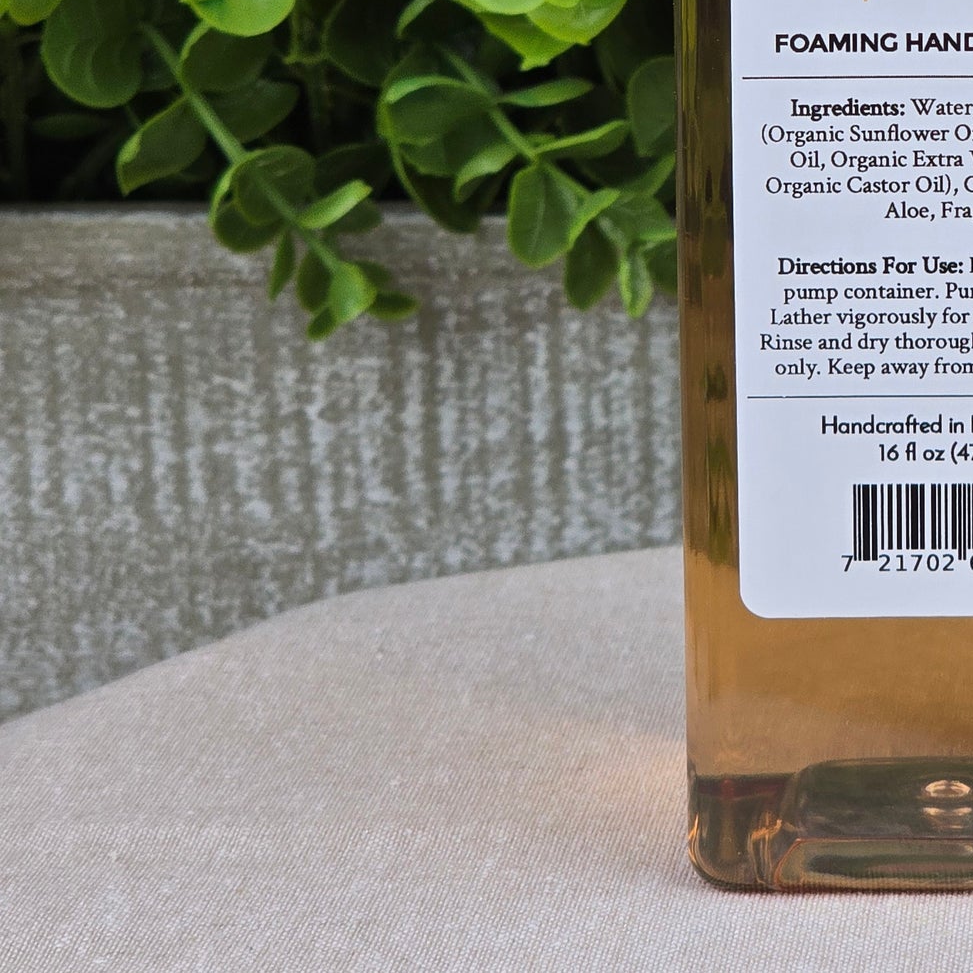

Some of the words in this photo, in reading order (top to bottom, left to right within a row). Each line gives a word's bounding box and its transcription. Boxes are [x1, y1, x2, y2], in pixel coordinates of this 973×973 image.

[775, 32, 899, 54] FOAMING
[790, 97, 906, 121] Ingredients:
[761, 123, 845, 146] (Organic
[849, 123, 950, 142] Sunflower
[789, 150, 826, 172] Oil,
[830, 150, 908, 172] Organic
[912, 149, 965, 168] Extra
[765, 176, 842, 199] Organic
[846, 175, 911, 194] Castor
[915, 173, 959, 197] Oil),
[884, 200, 936, 222] Aloe,
[777, 256, 878, 275] Directions
[881, 255, 918, 275] For
[921, 255, 964, 275] Use:
[783, 287, 839, 305] pump
[843, 282, 940, 300] container.
[770, 307, 833, 326] Lather
[835, 306, 938, 330] vigorously
[941, 306, 971, 325] for
[759, 333, 813, 351] Rinse
[818, 332, 853, 350] and
[857, 332, 890, 355] dry
[774, 357, 821, 381] only.
[827, 357, 876, 380] Keep
[880, 362, 930, 380] away
[821, 413, 943, 435] Handcrafted
[948, 417, 965, 434] in
[878, 443, 900, 462] 16
[904, 441, 917, 462] fl
[922, 448, 946, 462] oz
